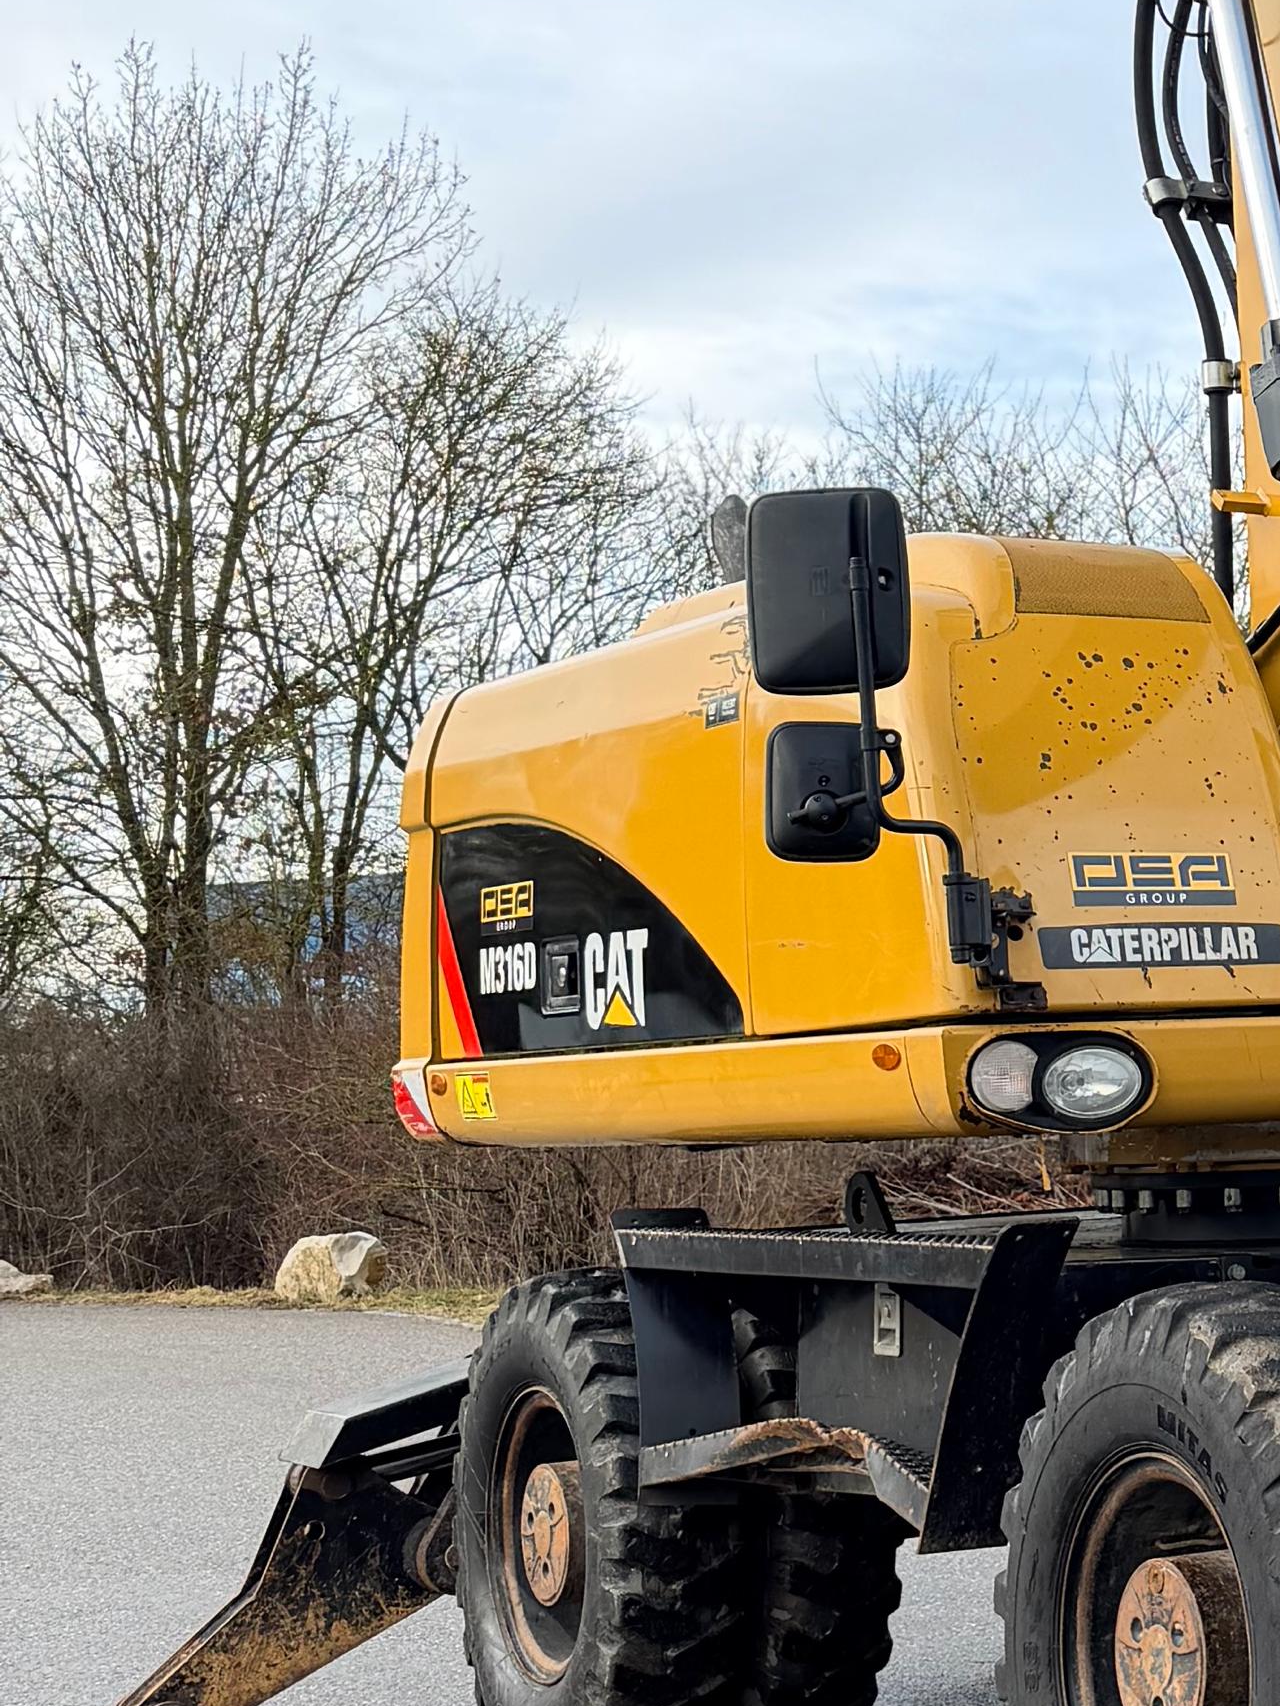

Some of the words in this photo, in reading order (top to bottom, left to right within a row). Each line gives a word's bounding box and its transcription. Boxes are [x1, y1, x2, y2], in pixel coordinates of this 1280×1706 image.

[1126, 893, 1187, 904] GROUP
[480, 942, 536, 994] M316D
[1070, 926, 1259, 963] CATERPILLAR
[584, 928, 649, 1030] CAT
[1157, 1404, 1228, 1505] MITAS
